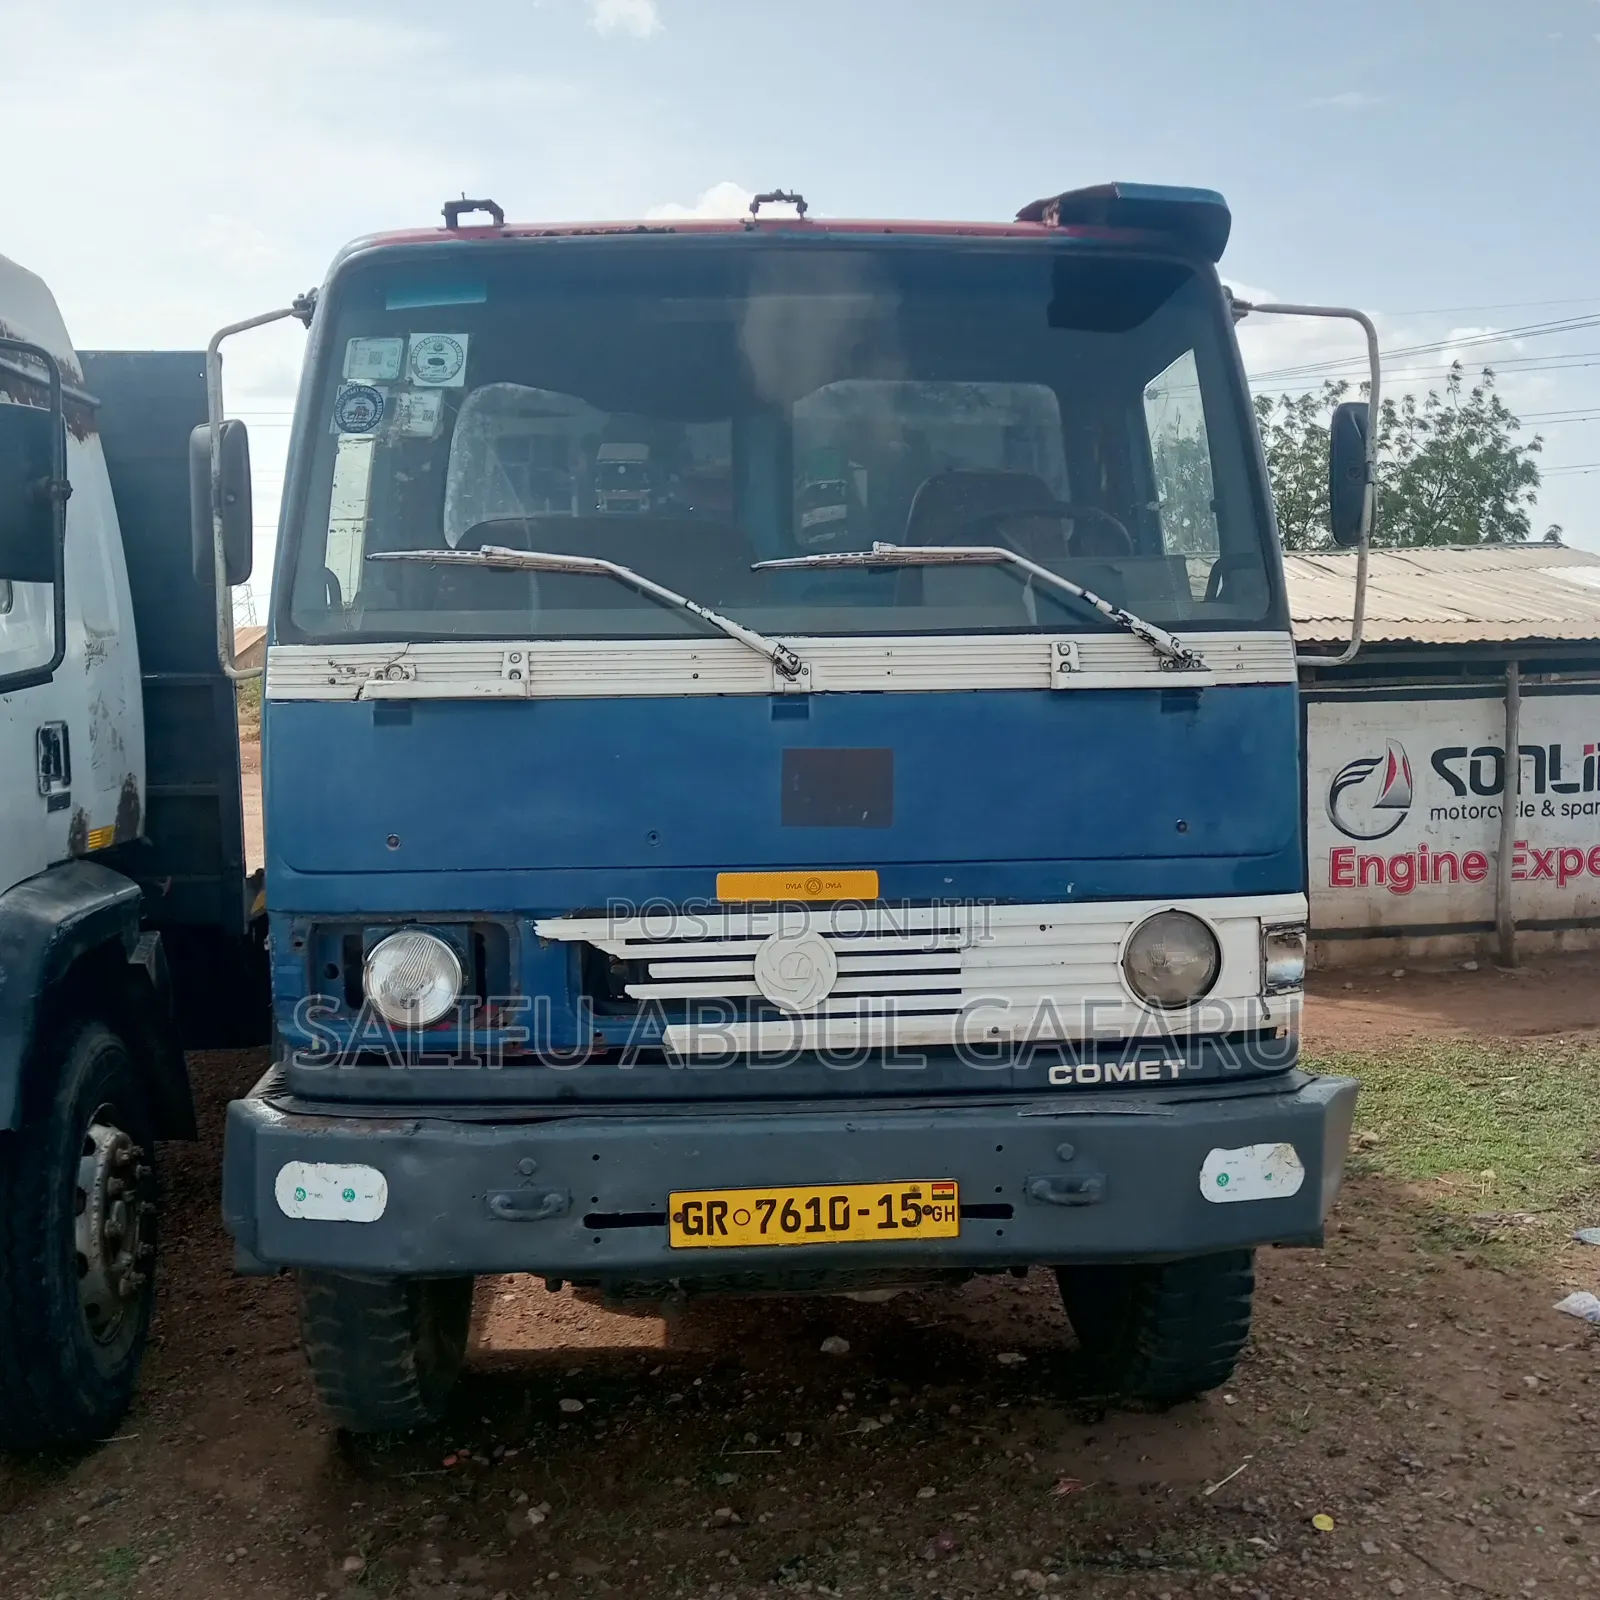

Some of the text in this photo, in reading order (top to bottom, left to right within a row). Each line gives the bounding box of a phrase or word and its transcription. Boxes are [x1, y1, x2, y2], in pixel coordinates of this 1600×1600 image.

[1430, 800, 1535, 820] motorcle
[1541, 800, 1555, 816] &
[1329, 843, 1488, 895] Engine
[1048, 1059, 1185, 1084] COMET
[682, 1200, 728, 1235] GR
[932, 1205, 955, 1222] GH
